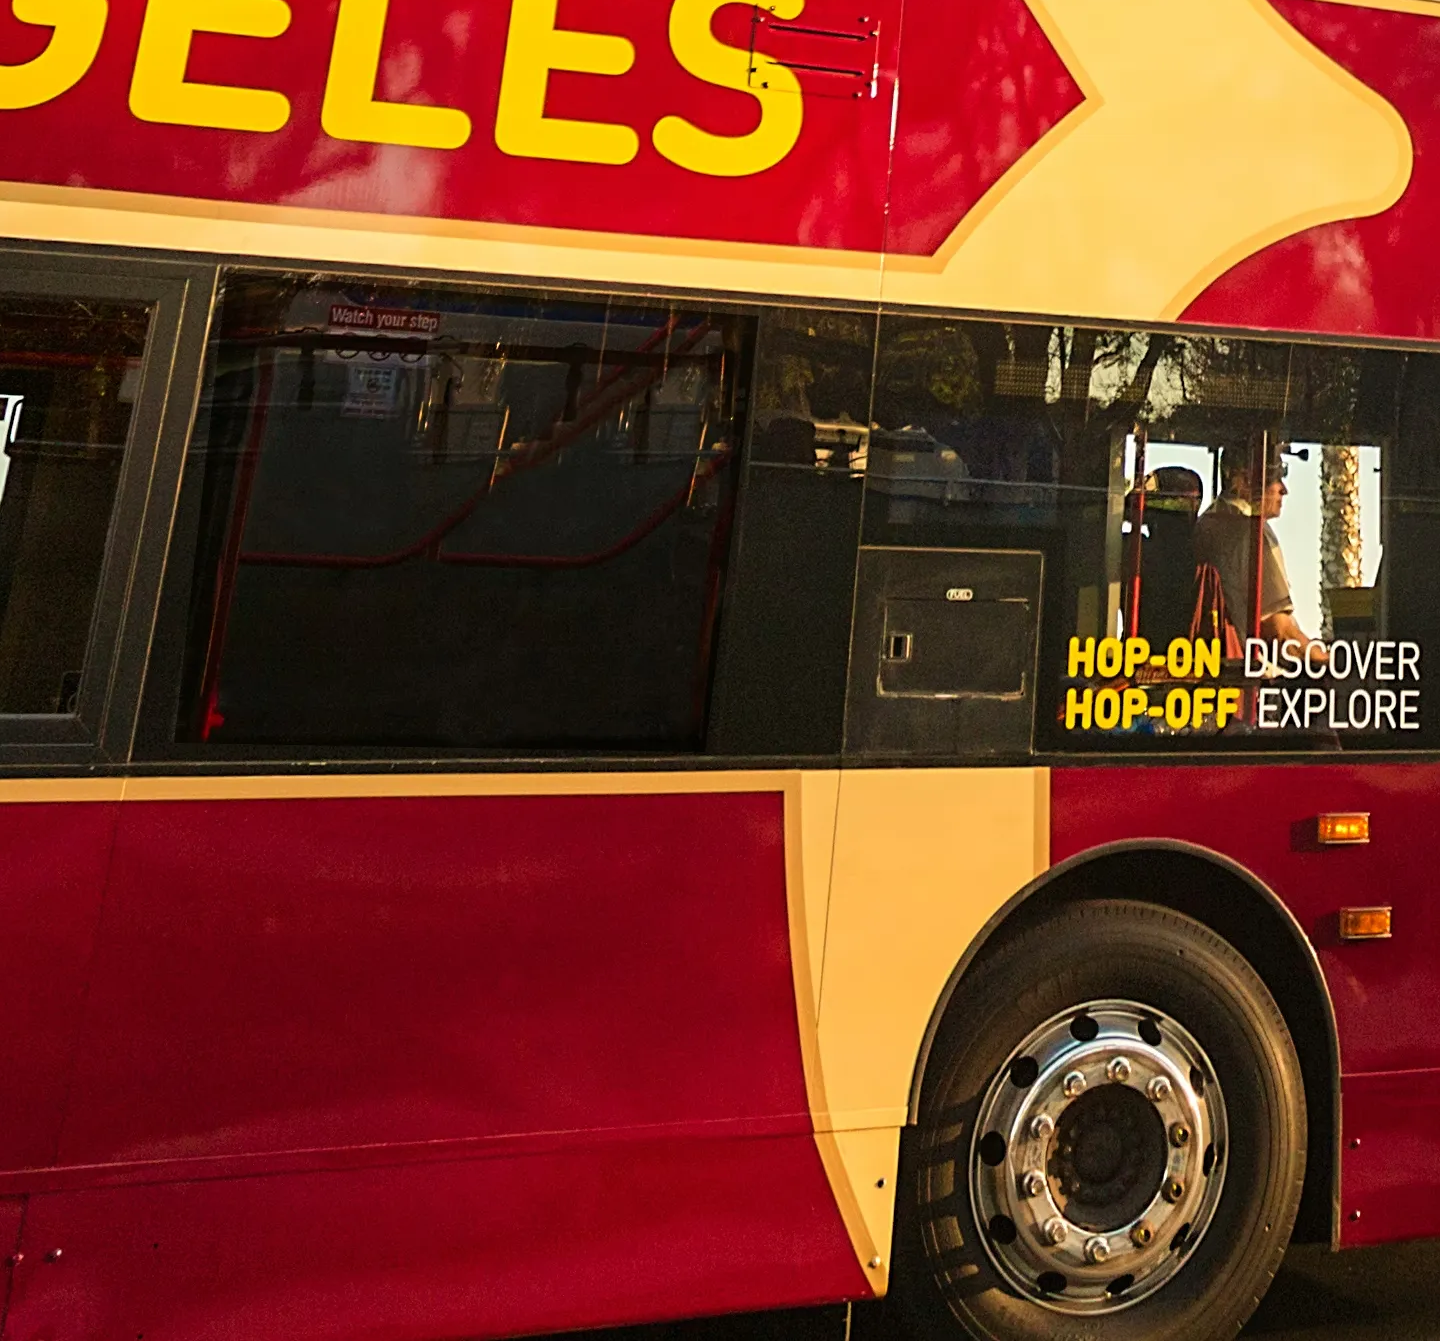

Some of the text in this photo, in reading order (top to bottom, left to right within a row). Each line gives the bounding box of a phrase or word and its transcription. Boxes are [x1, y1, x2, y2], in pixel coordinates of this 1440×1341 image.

[331, 307, 438, 332] Watch your step
[948, 590, 972, 600] FUEL
[1067, 636, 1421, 681] HOP-ON DISCOVER
[1065, 687, 1421, 730] HOP-OFF EXPLORE
